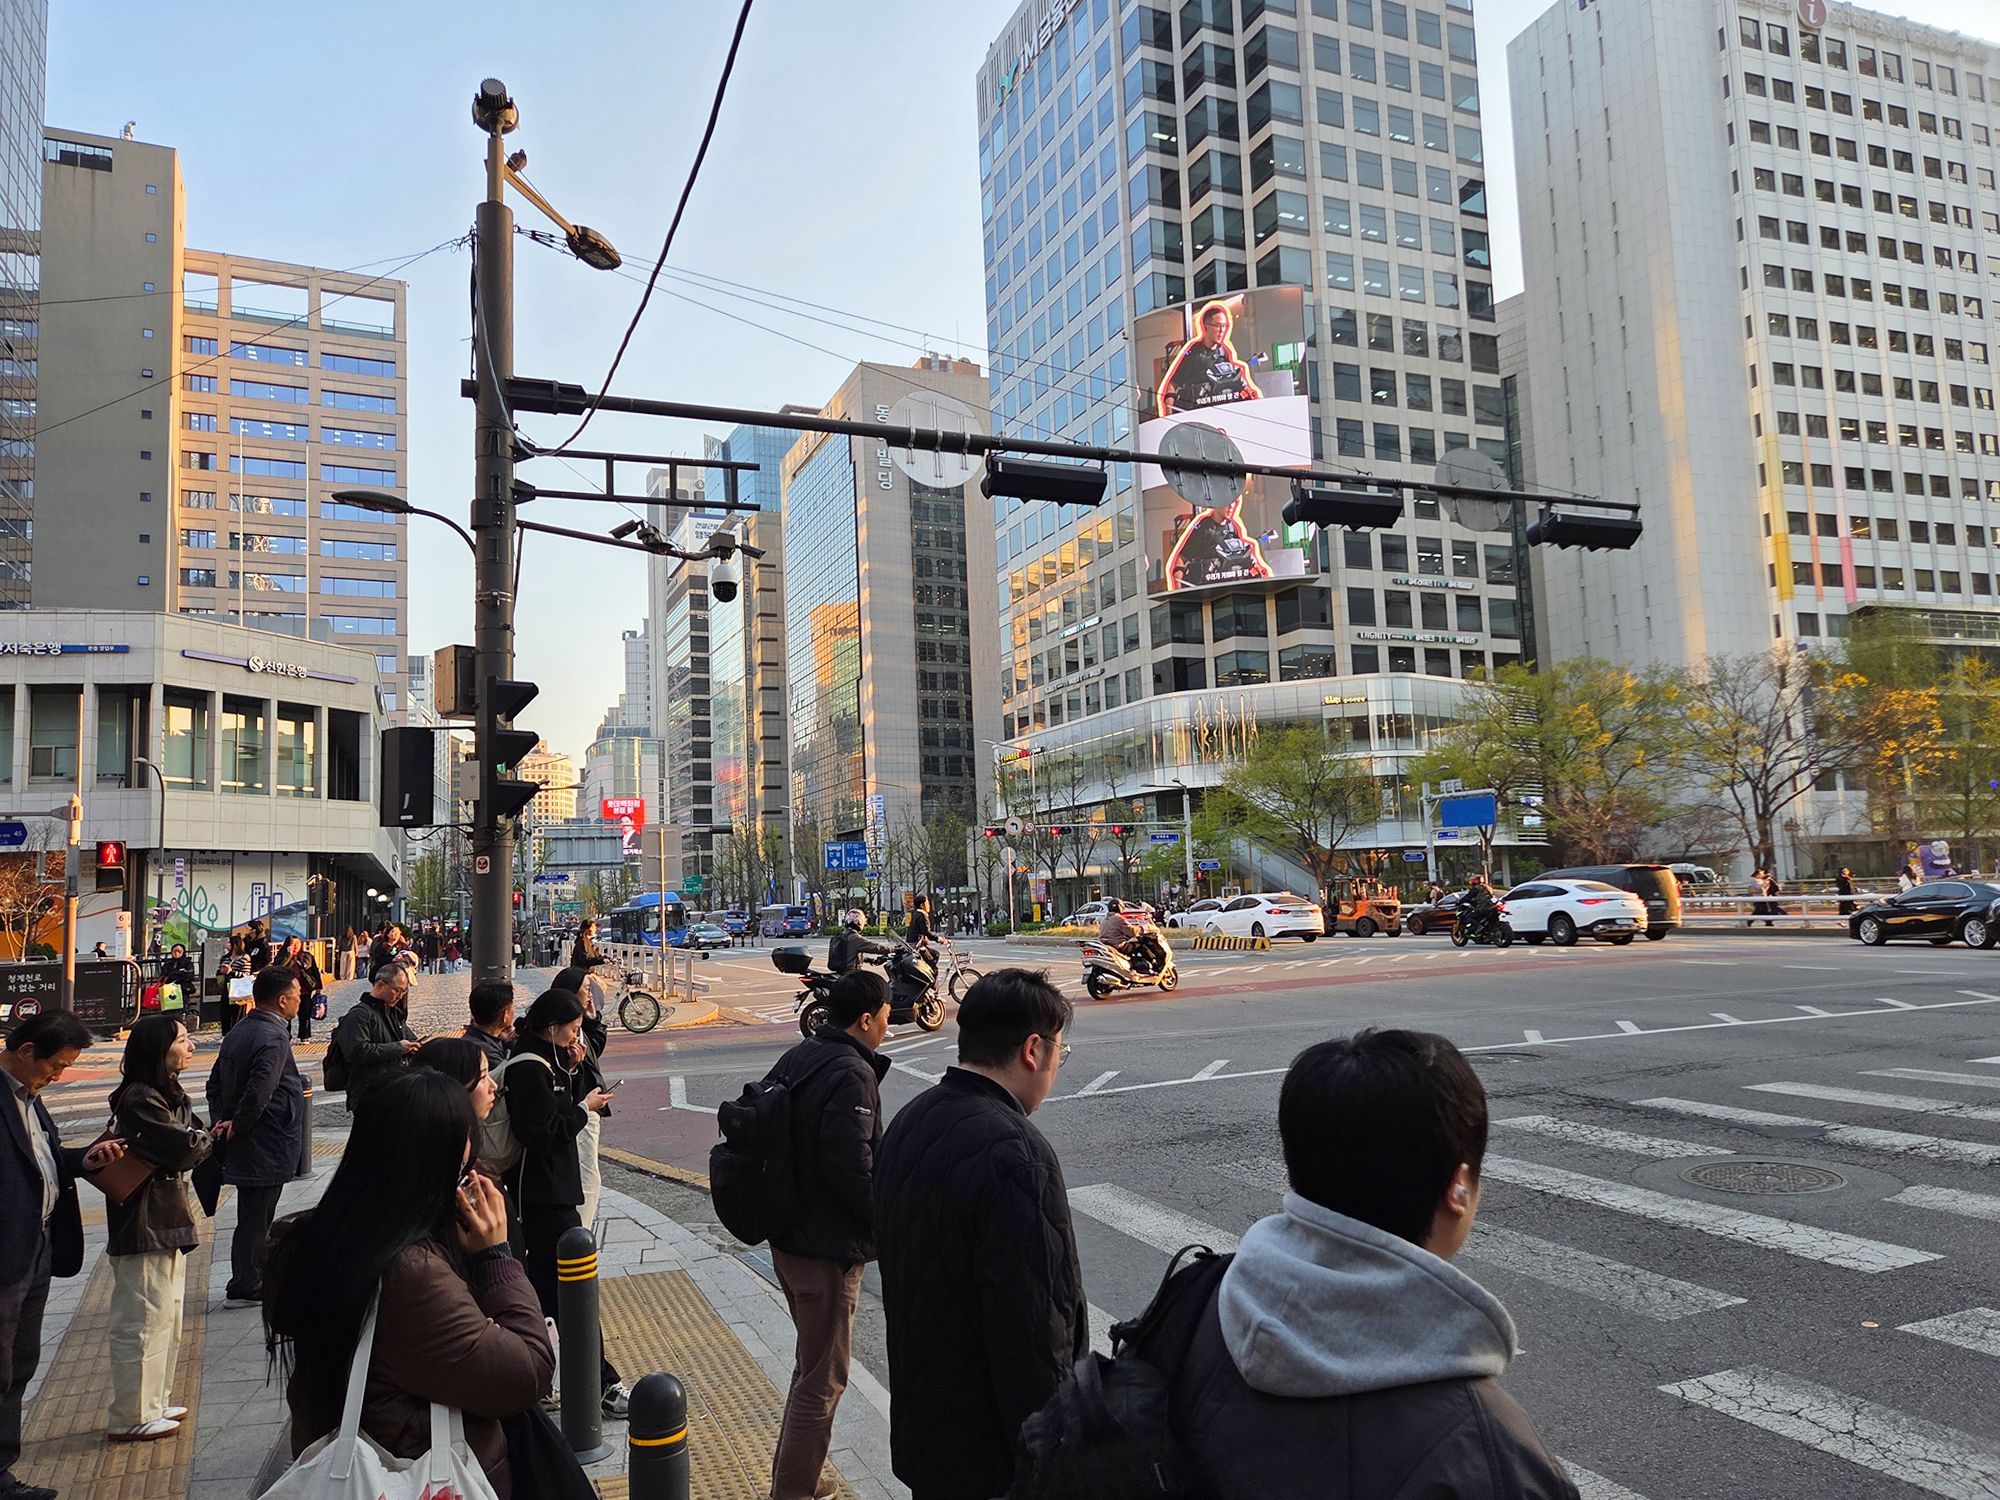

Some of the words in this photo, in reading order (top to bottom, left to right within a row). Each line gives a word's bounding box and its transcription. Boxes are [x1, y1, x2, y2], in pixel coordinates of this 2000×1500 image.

[1020, 0, 1081, 74] iM금융
[875, 404, 893, 490] 동빌딩
[1360, 631, 1392, 640] DIGNITY
[265, 660, 307, 678] 신한은행
[7, 973, 43, 984] 청계천로
[19, 984, 36, 993] 없는
[39, 982, 56, 991] 거리
